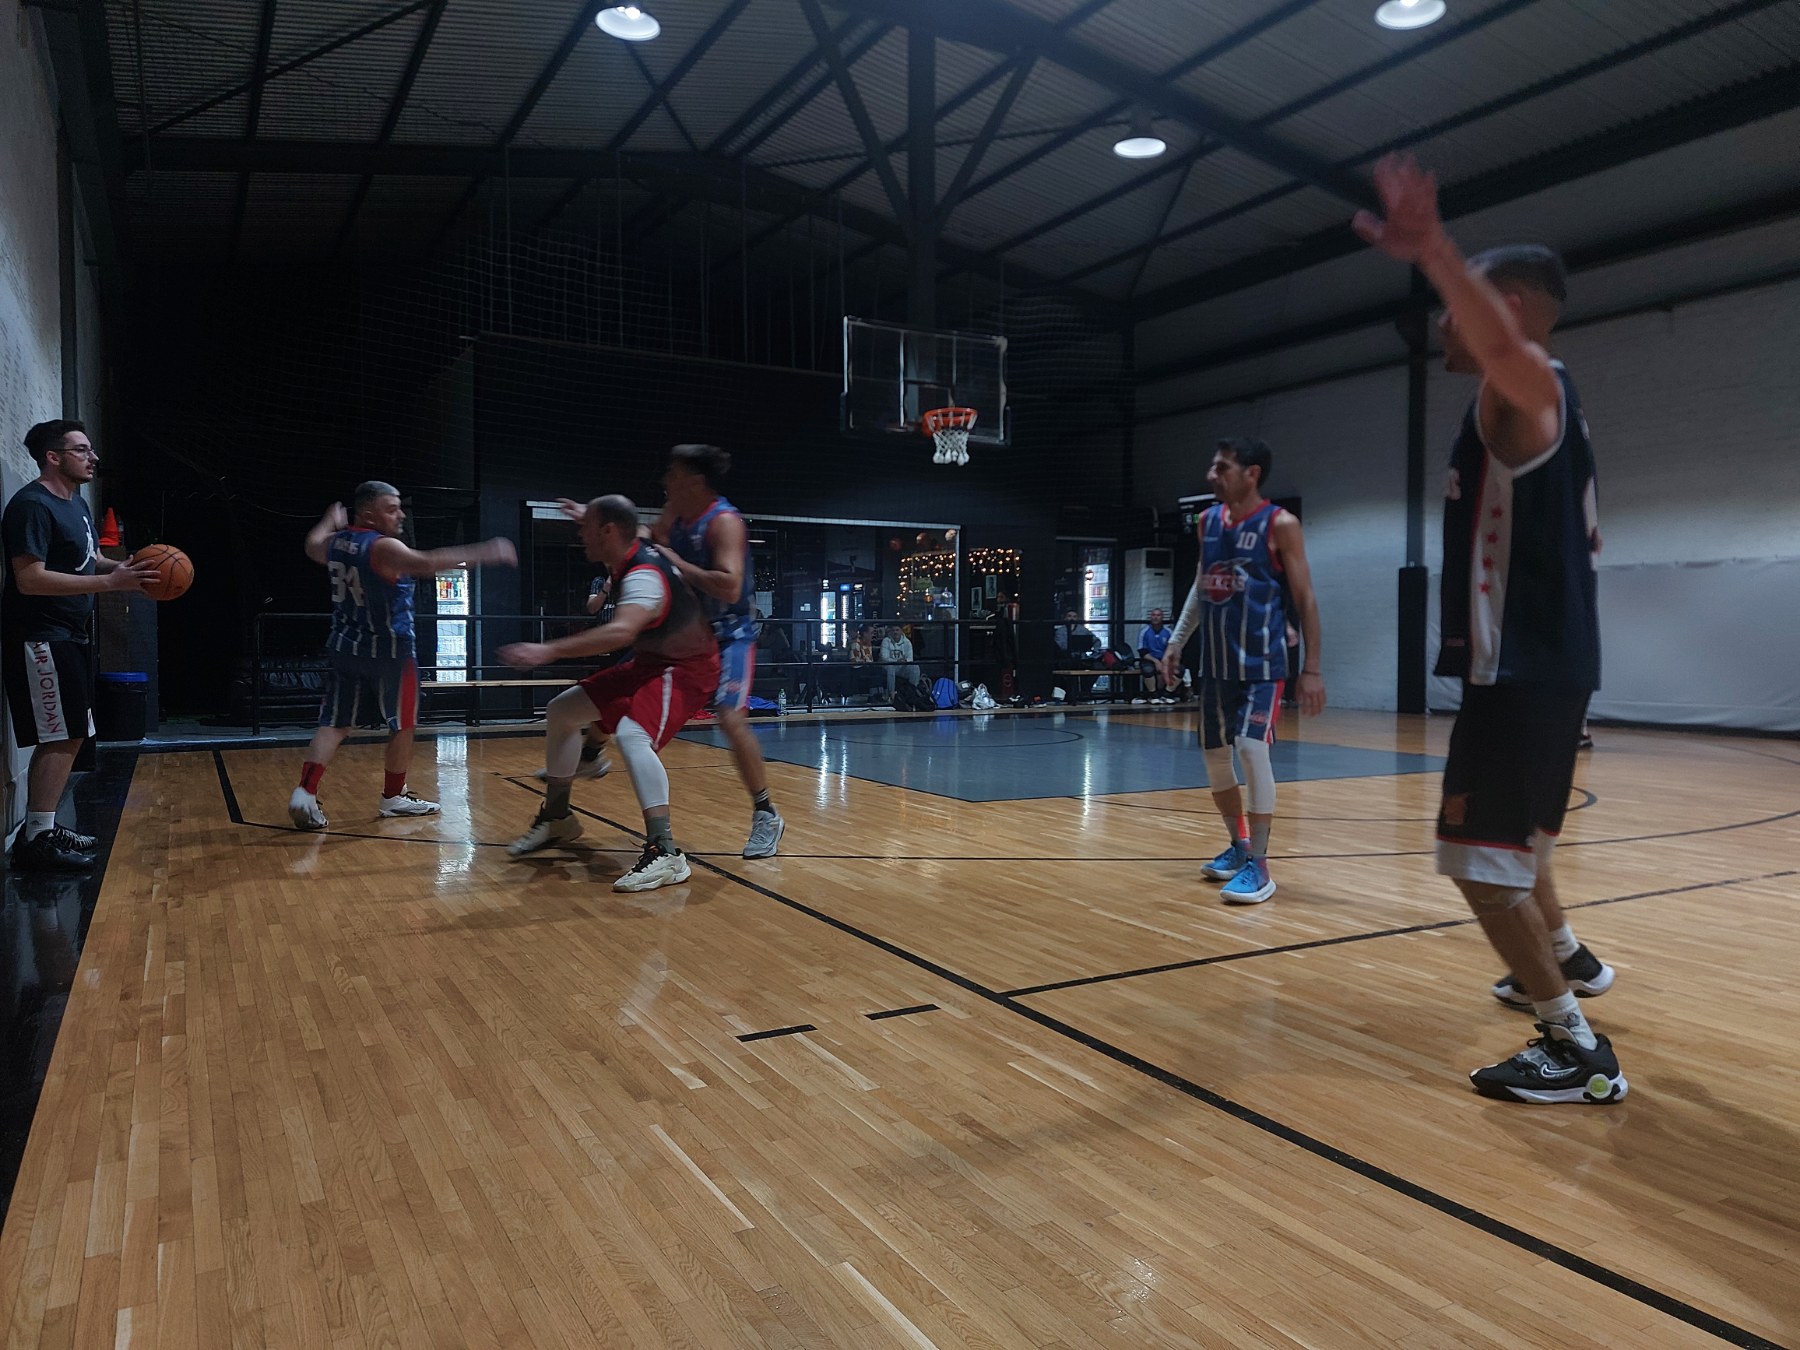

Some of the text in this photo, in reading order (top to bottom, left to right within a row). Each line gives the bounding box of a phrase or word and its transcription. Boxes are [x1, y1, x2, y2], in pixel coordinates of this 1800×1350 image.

[1235, 531, 1258, 550] 10
[328, 560, 365, 607] 34
[37, 669, 63, 734] JORDAN
